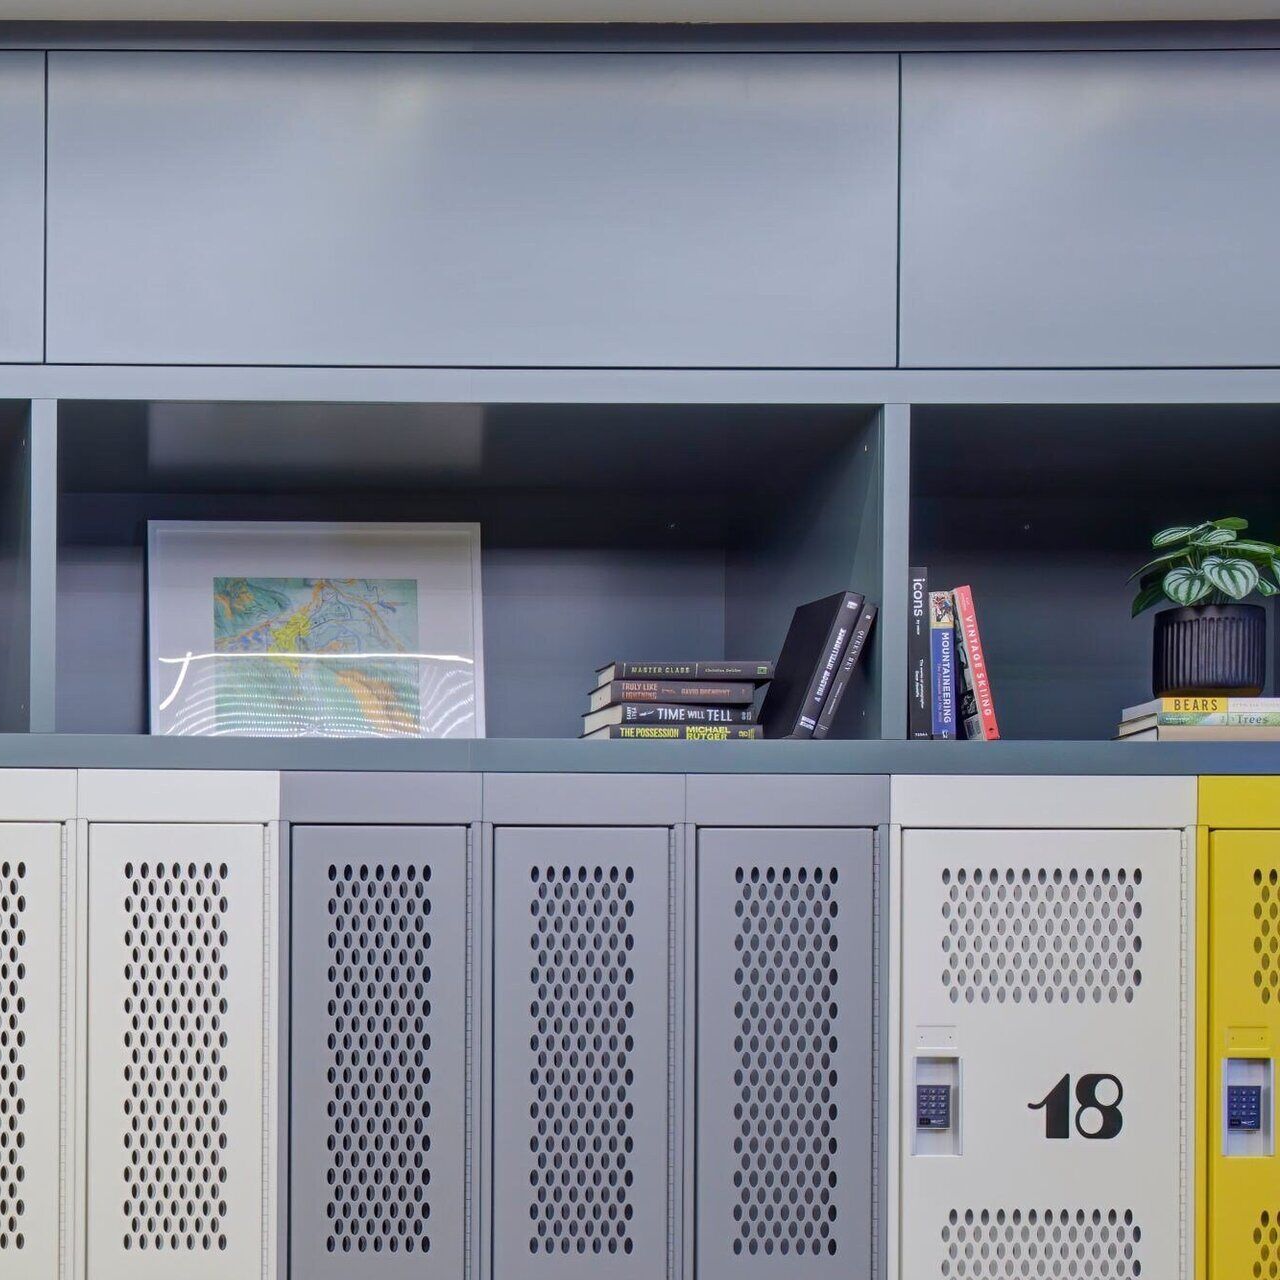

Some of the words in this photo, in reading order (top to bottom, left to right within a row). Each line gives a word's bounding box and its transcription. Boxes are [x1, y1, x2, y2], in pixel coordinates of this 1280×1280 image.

[912, 578, 925, 617] icons
[965, 614, 984, 668] VINTAGE
[976, 672, 992, 716] SKIING
[942, 632, 951, 723] MOUNTAINEERING
[643, 683, 657, 691] LIKE
[1174, 699, 1218, 711] BEARS
[657, 708, 685, 720] TIME
[687, 710, 705, 719] WILL
[707, 709, 733, 721] TELL
[620, 728, 635, 738] THE
[636, 728, 679, 738] POSSESSION
[685, 733, 728, 741] RUTGER
[1027, 1073, 1123, 1139] 18
